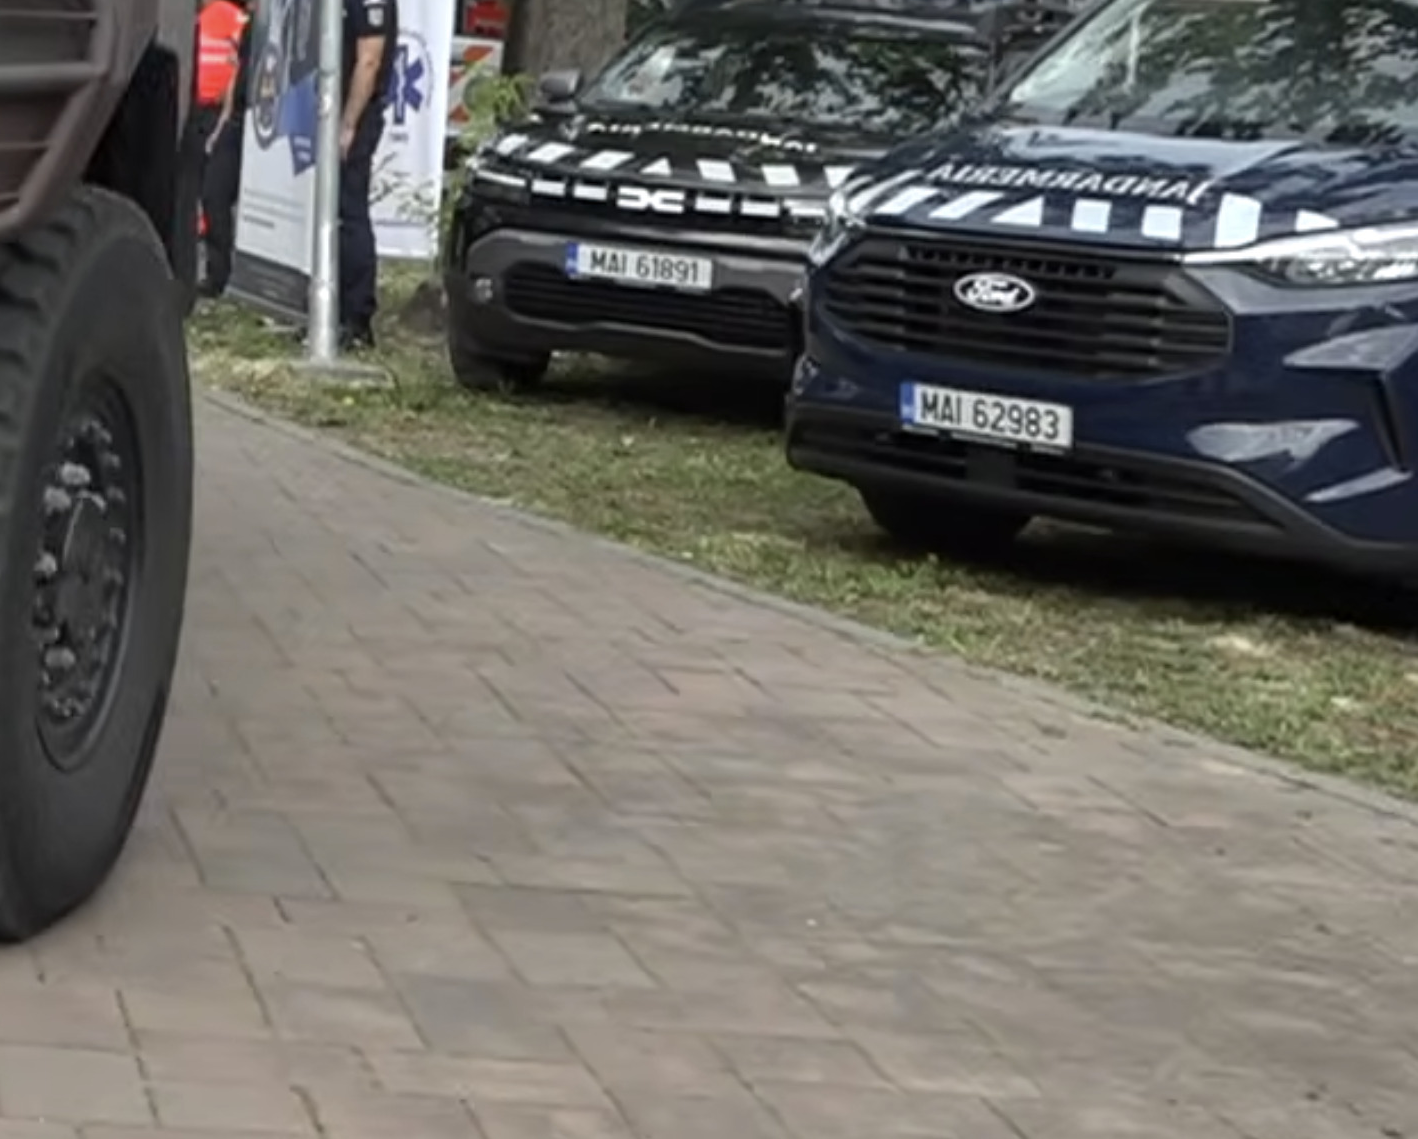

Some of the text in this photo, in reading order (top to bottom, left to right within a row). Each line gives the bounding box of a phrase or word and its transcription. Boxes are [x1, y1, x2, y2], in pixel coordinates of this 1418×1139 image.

[590, 250, 699, 282] MAI 61891
[921, 392, 1059, 439] MAI 62983
